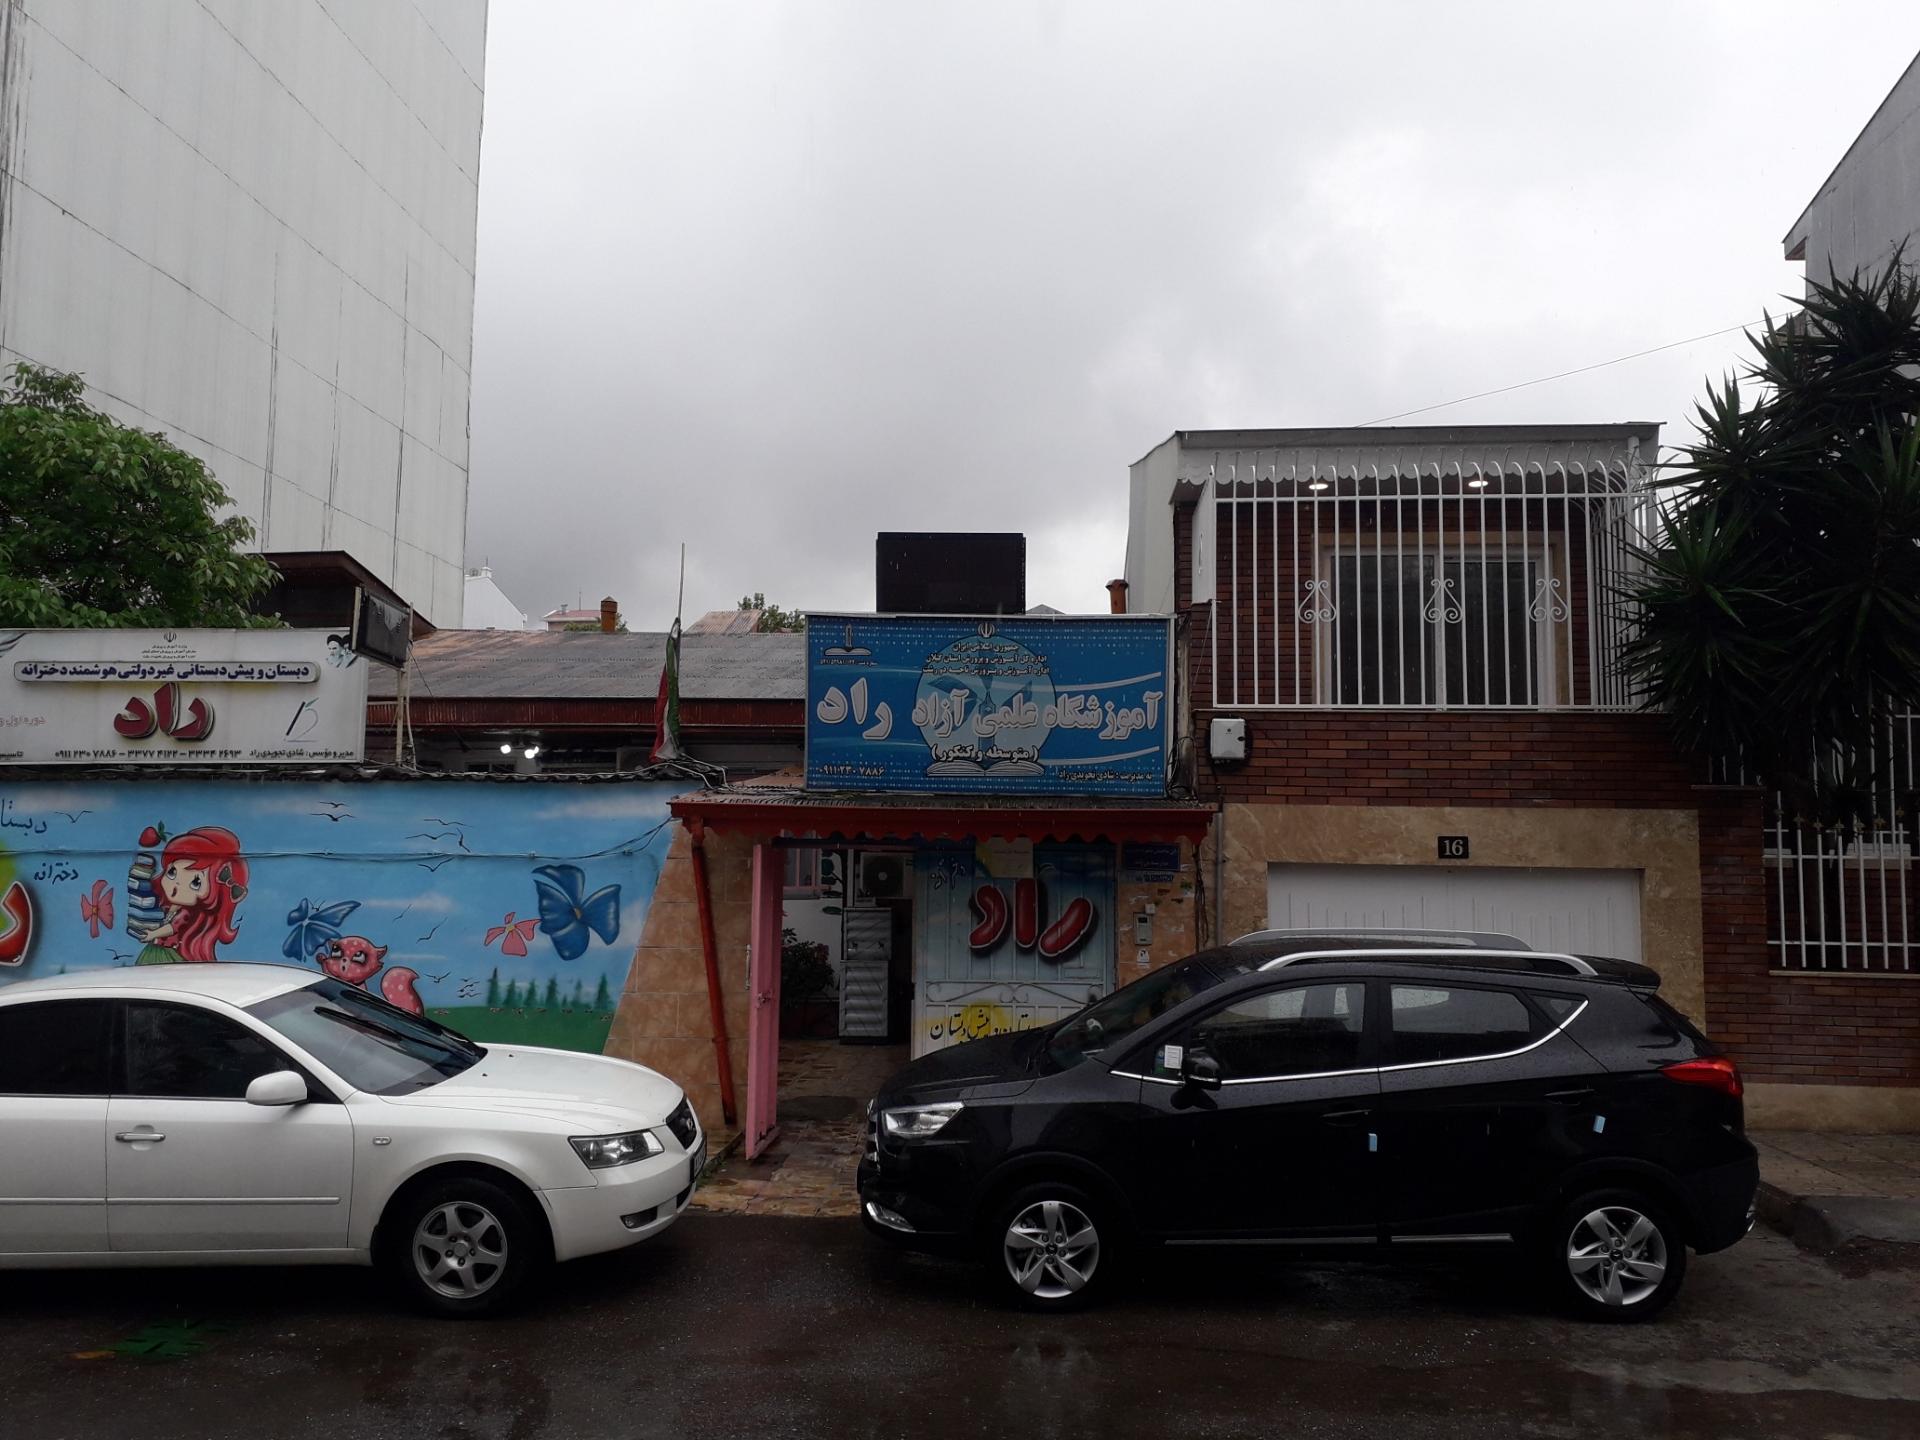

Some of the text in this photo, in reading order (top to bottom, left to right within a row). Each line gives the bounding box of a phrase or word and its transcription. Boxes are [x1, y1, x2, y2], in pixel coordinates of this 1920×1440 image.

[952, 642, 1019, 653] جمهوری اسلامی ایران
[21, 664, 67, 679] دخترانه
[69, 664, 117, 679] هوشمند
[227, 664, 255, 680] پیش
[258, 667, 264, 679] و
[265, 664, 309, 680] دبستان
[113, 682, 216, 740] راد
[817, 677, 1163, 740] آموزشگاه علمی آزاد راد
[338, 750, 354, 759] مدیر
[1443, 839, 1464, 856] 16
[34, 861, 79, 885] دخترانه
[968, 878, 1094, 958] راد
